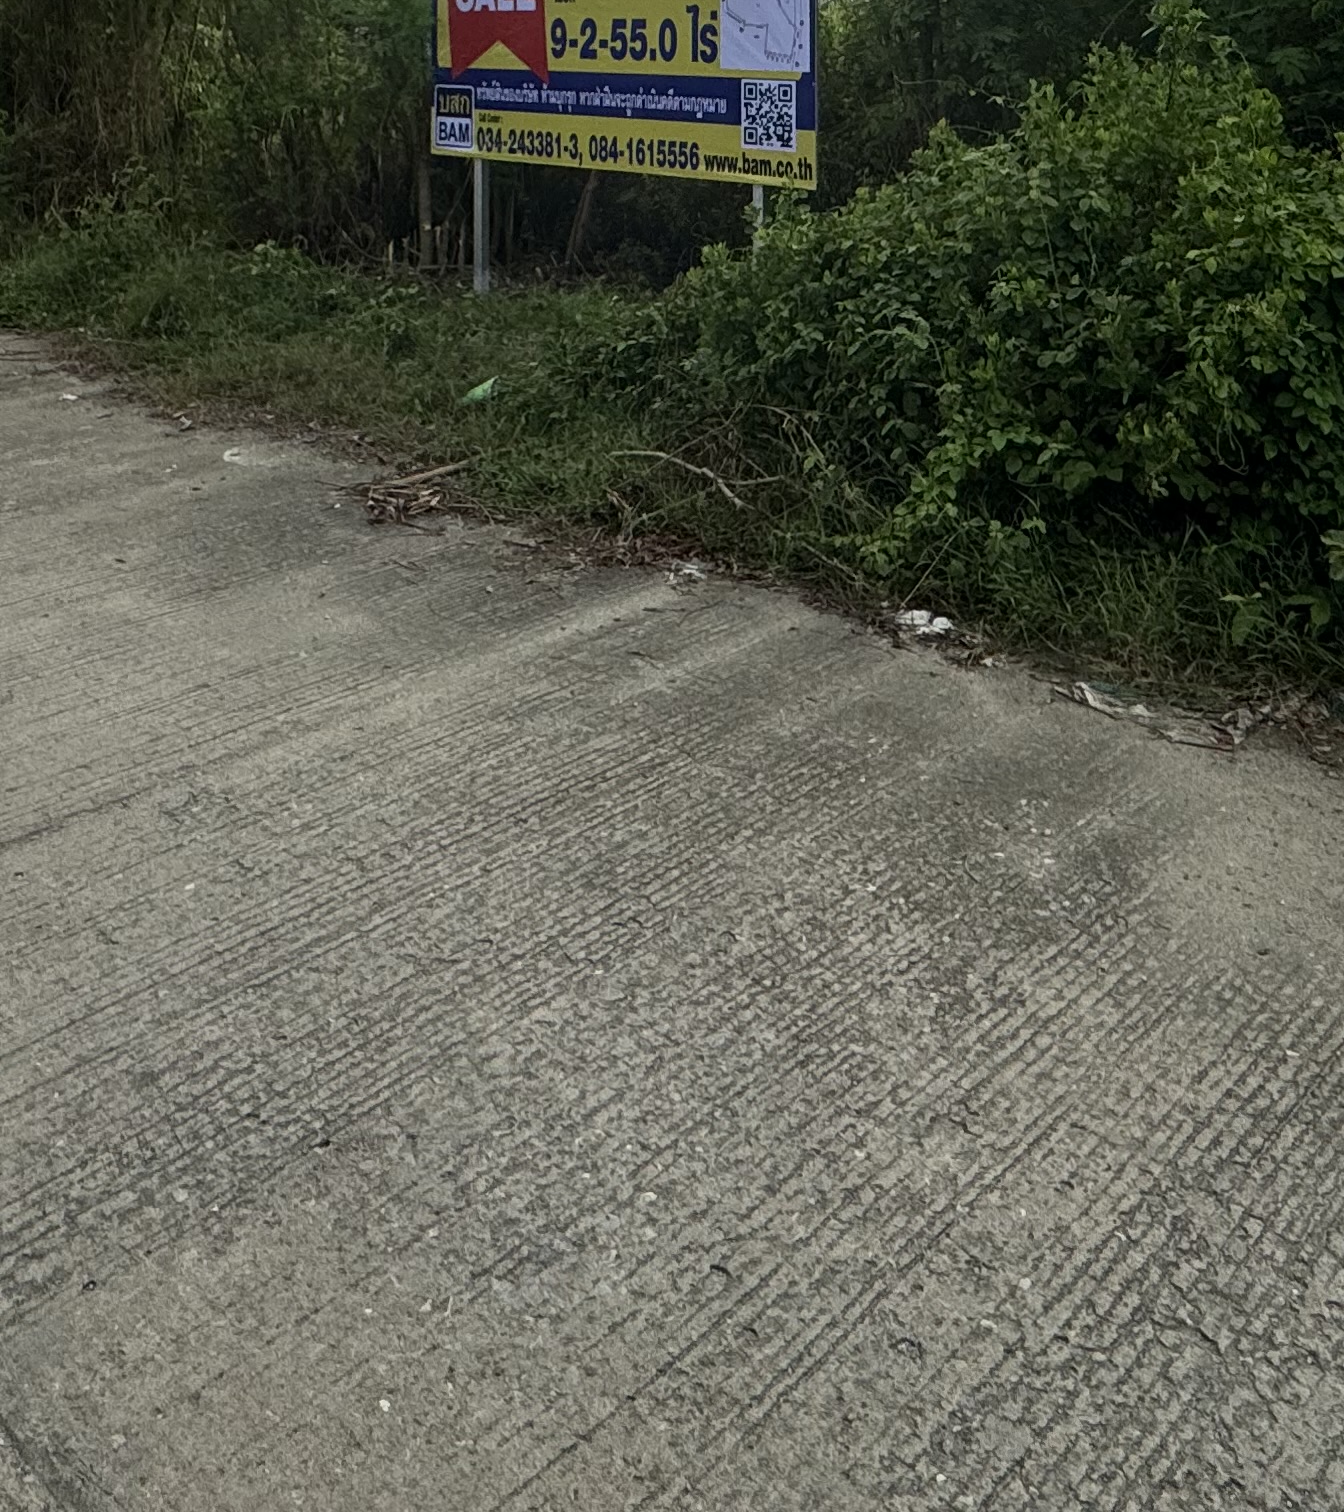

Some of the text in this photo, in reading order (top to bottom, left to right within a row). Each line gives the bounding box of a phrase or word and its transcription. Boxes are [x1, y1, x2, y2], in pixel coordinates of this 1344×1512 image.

[551, 4, 718, 64] 9-2-55.0 ไร่
[439, 93, 470, 115] บสก
[439, 120, 470, 143] BAM
[477, 126, 813, 181] 034-243381-3, 084-1615556 www.bam.co.th
